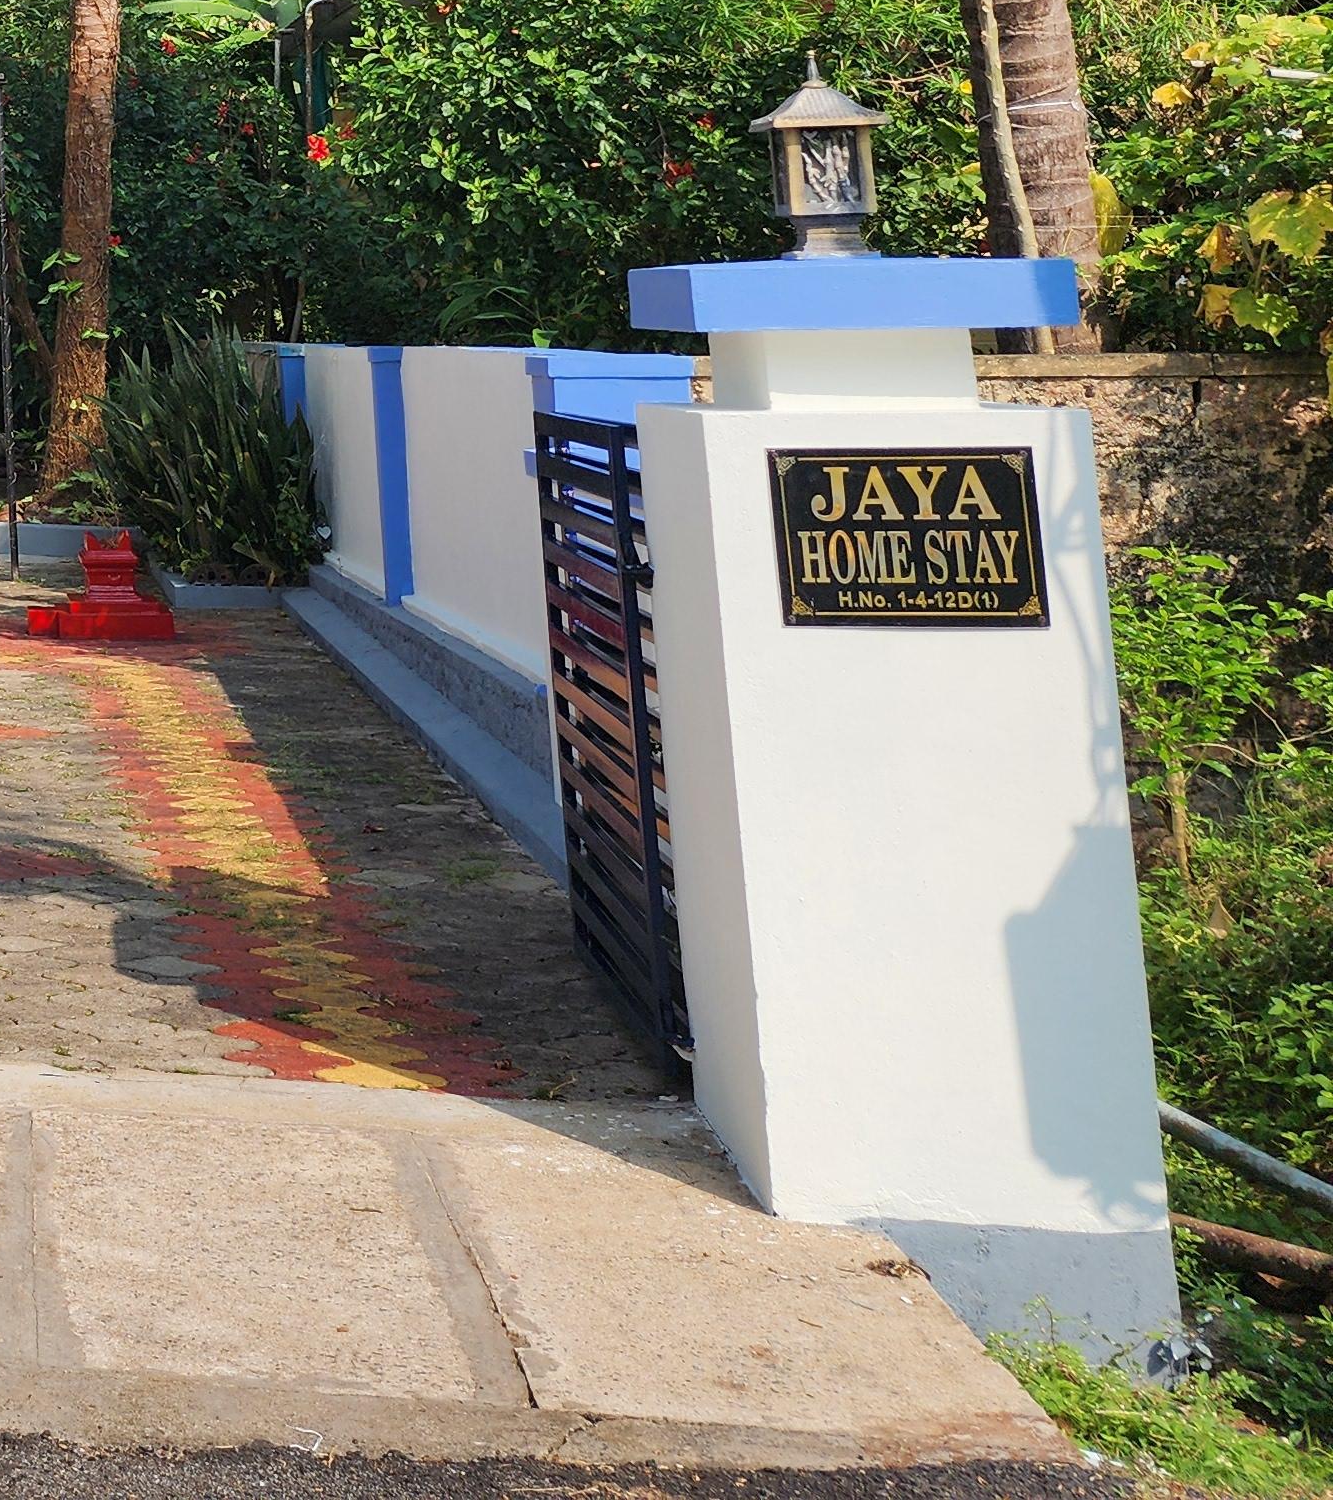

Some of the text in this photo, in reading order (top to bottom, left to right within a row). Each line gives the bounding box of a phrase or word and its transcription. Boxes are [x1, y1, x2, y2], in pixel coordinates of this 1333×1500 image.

[810, 464, 1002, 522] JAYA
[796, 529, 1019, 585] HOME STAY
[838, 590, 892, 609] H.No.
